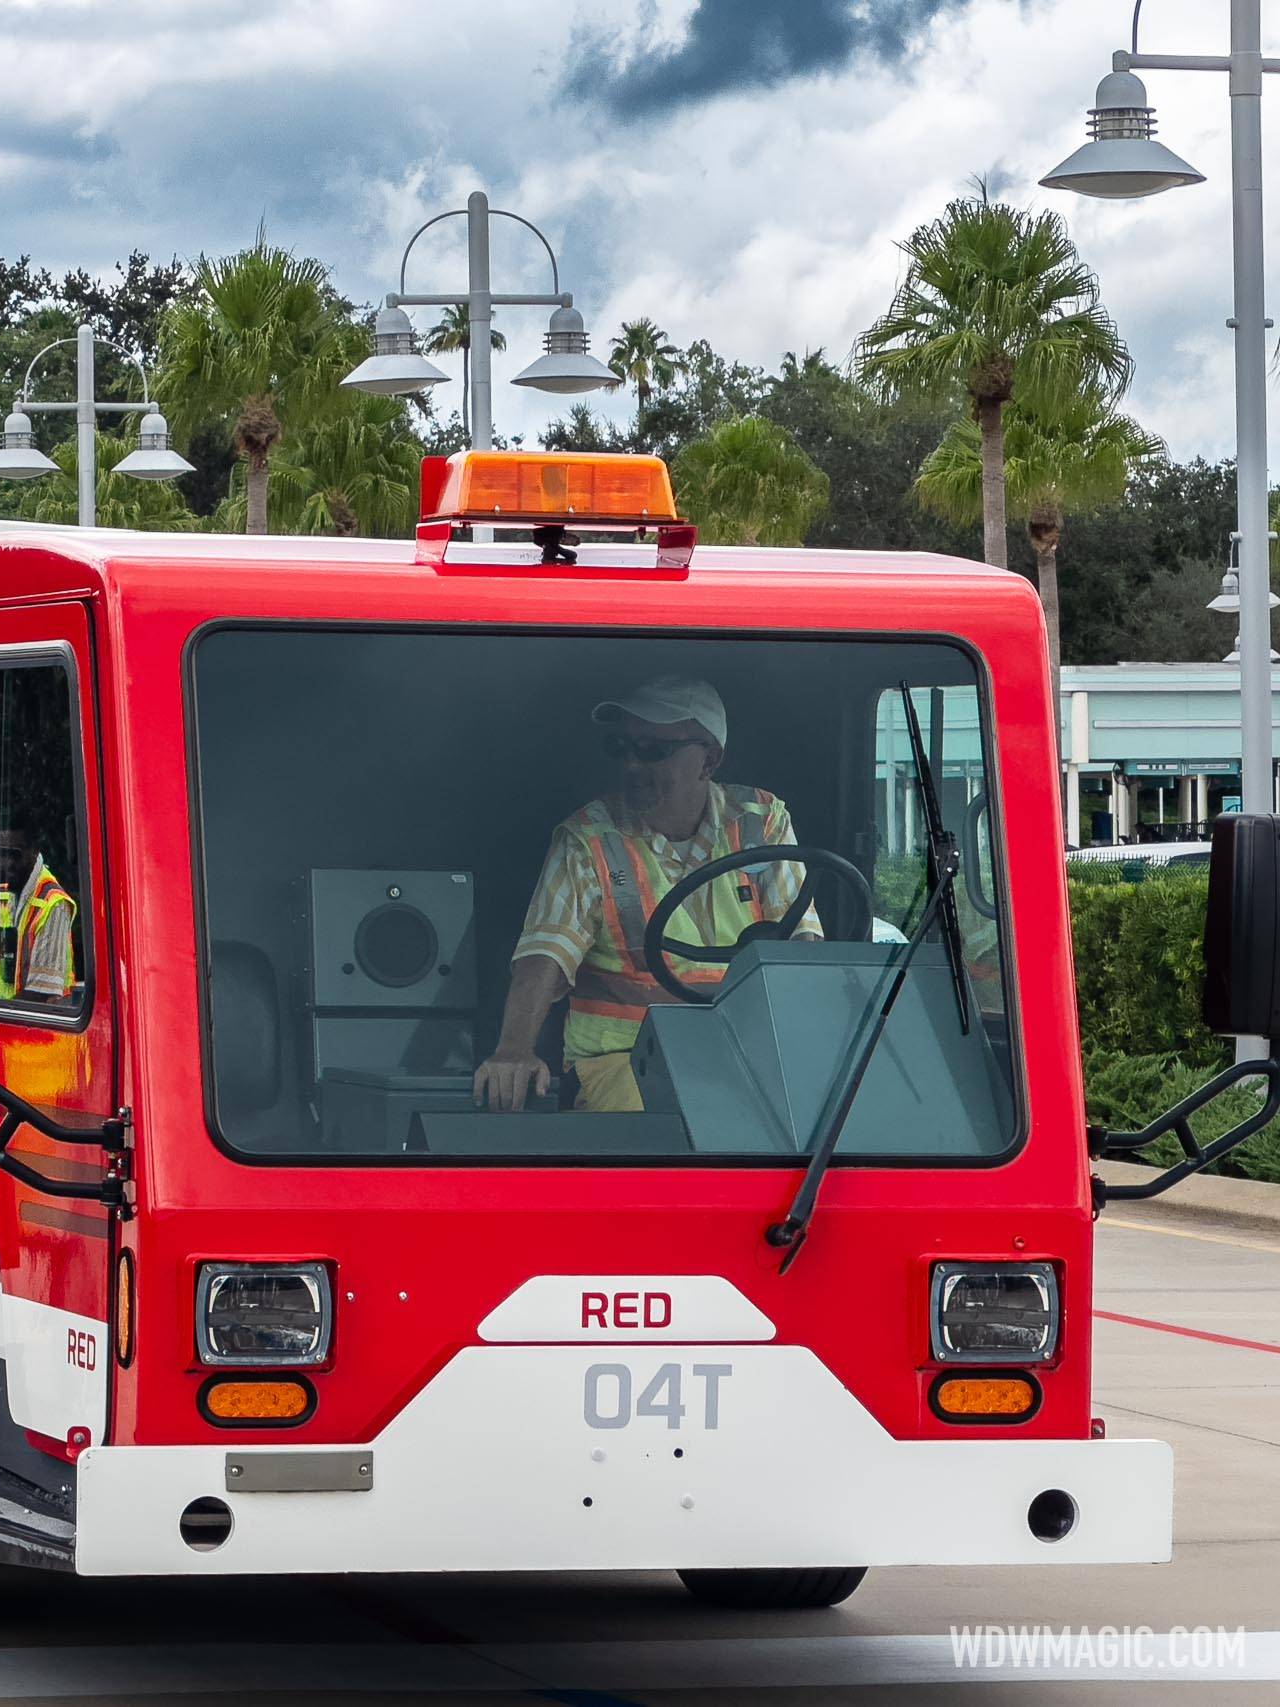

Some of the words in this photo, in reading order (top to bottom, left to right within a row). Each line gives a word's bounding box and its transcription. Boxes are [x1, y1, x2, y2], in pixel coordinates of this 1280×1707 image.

[581, 1292, 672, 1328] RED
[67, 1328, 96, 1371] RED
[583, 1363, 733, 1430] 04T
